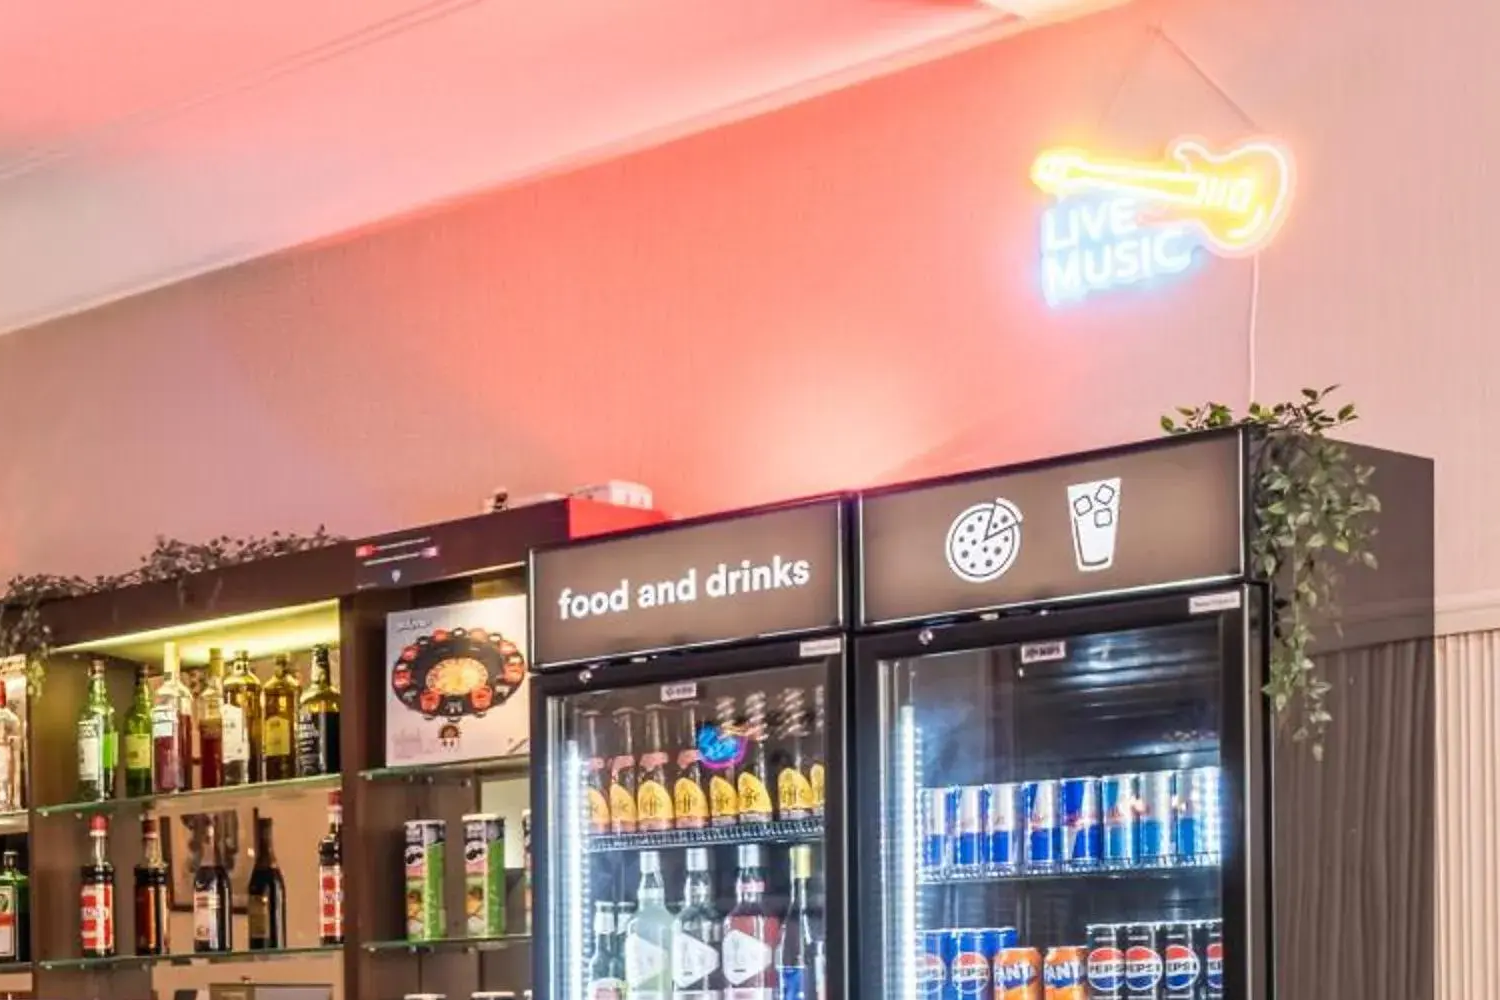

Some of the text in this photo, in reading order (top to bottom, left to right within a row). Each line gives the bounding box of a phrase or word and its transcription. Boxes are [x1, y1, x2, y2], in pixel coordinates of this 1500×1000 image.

[1042, 197, 1137, 249] LIVE
[1042, 228, 1191, 304] MUSIC
[558, 555, 810, 620] food and drinks
